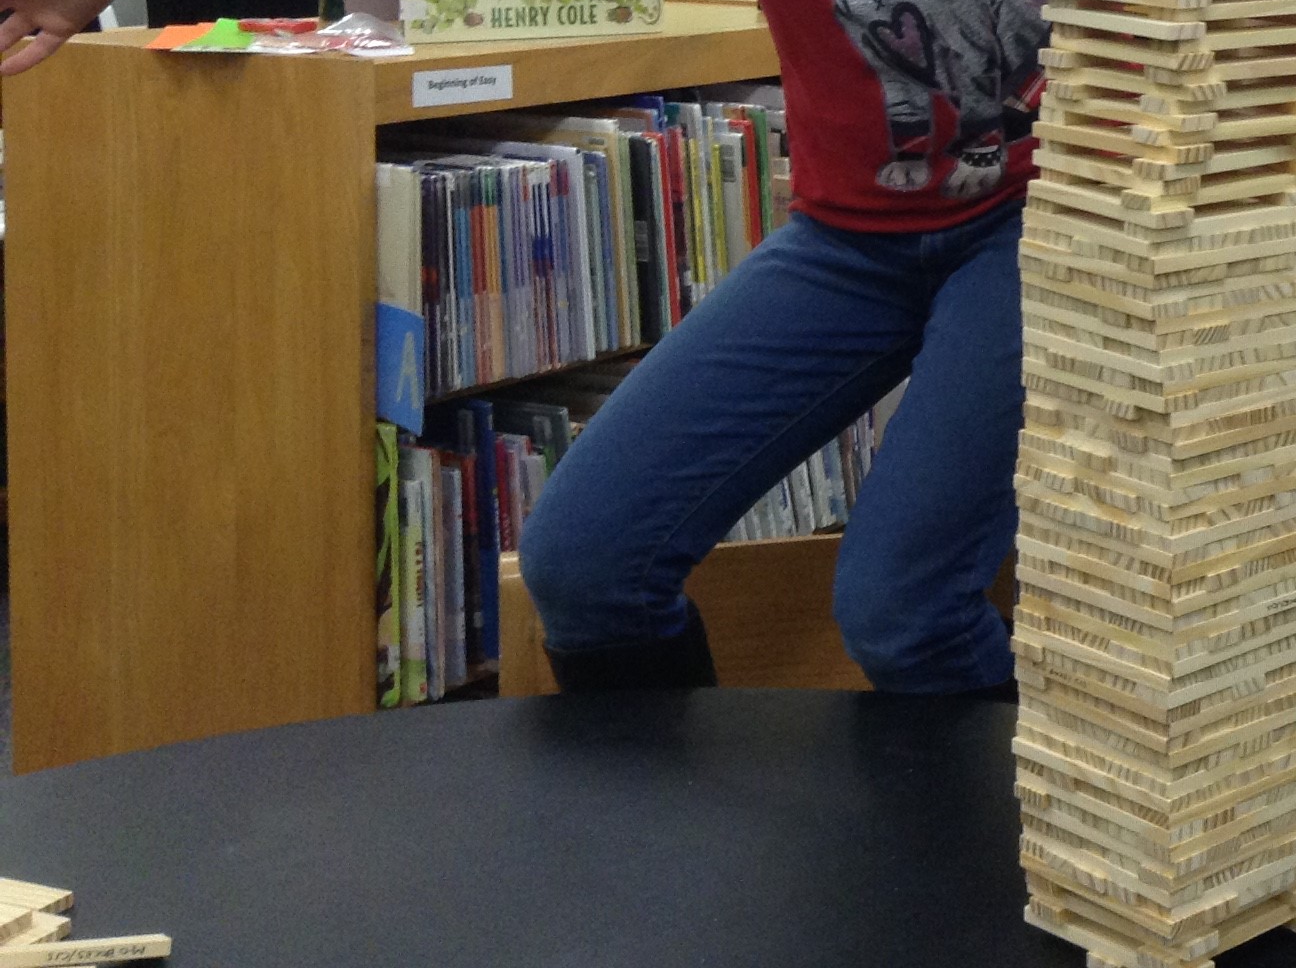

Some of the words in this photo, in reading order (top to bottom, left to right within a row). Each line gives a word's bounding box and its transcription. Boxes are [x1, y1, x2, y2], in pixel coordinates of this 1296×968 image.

[490, 5, 550, 28] HENRY
[557, 4, 598, 25] COLE
[428, 78, 468, 91] Beginning
[469, 76, 479, 86] of
